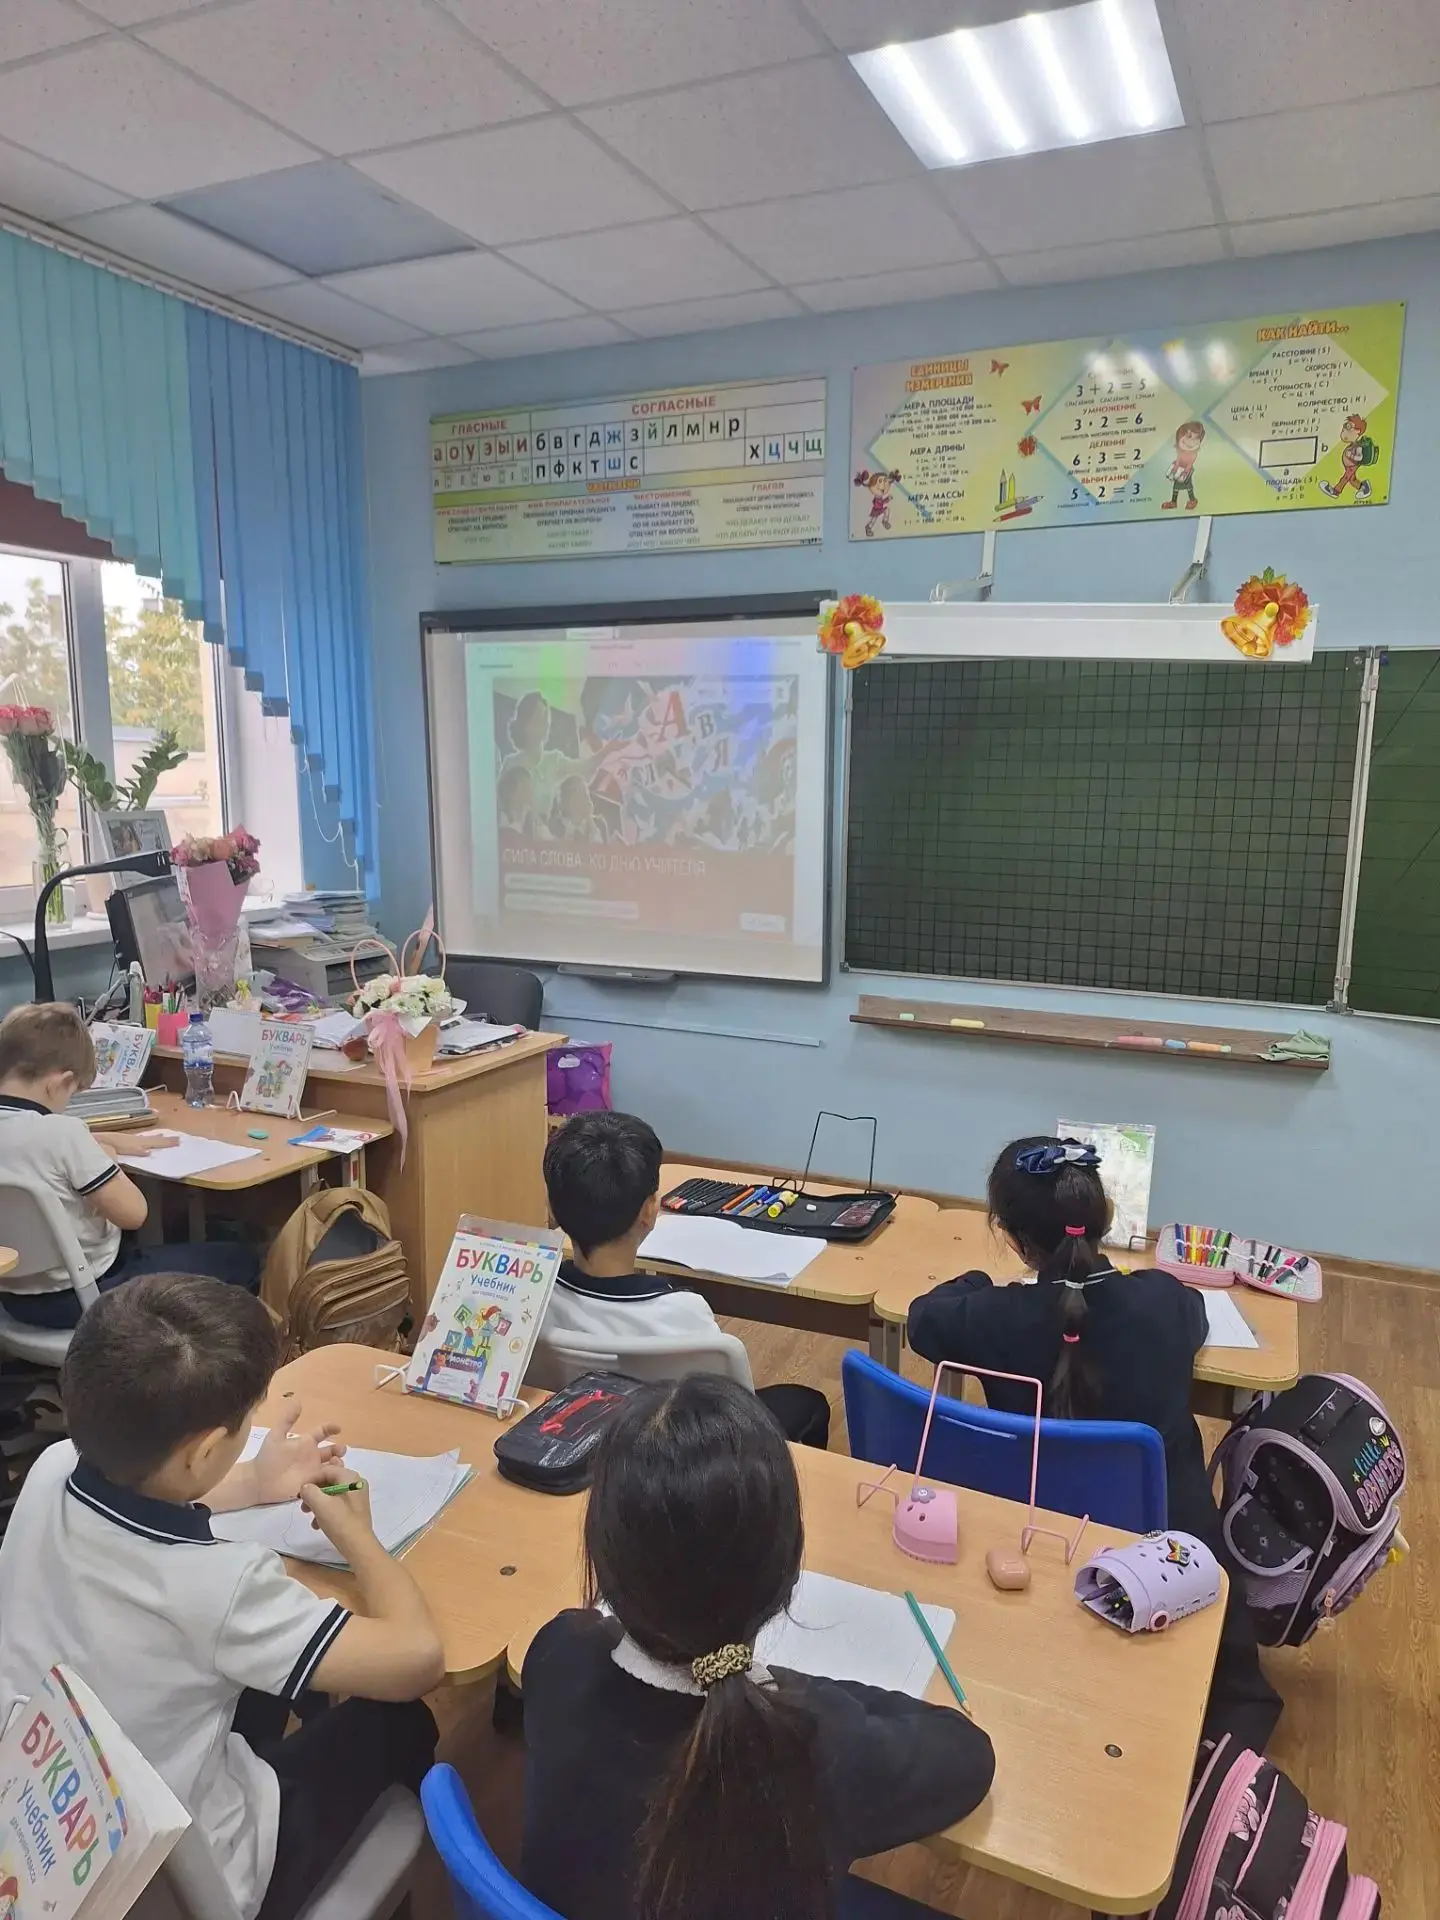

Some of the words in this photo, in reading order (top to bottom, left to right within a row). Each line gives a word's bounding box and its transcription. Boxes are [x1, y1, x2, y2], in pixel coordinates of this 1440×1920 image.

[1257, 327, 1286, 342] КАК
[911, 359, 969, 377] ЕДИНИЦЫ
[905, 373, 973, 392] ИЗМЕРЕНИЯ
[1076, 385, 1083, 397] 3
[1107, 382, 1115, 394] 2
[1139, 378, 1146, 390] 5
[1269, 382, 1312, 392] СТОИМОСТЬ
[632, 395, 717, 415] СОГЛАСНЫЕ
[904, 402, 926, 410] МЕРА
[929, 396, 974, 408] ПЛОЩАДИ
[1083, 403, 1136, 415] УМНОЖЕНИЕ
[452, 420, 508, 435] ГЛАСНЫЕ
[1074, 419, 1082, 431] 3
[1101, 416, 1108, 428] 2
[1135, 412, 1143, 425] 6
[536, 433, 546, 451] б
[554, 436, 563, 449] в
[574, 433, 581, 448] г
[589, 432, 600, 448] д
[607, 431, 621, 444] ж
[631, 428, 639, 441] з
[648, 422, 657, 439] й
[666, 424, 677, 438] л
[686, 423, 700, 436] м
[710, 420, 719, 434] н
[729, 418, 740, 436] р
[449, 446, 459, 460] о
[499, 440, 509, 454] ы
[516, 438, 527, 453] и
[910, 447, 931, 456] МЕРА
[935, 444, 965, 454] ДЛИНЫ
[1089, 439, 1126, 449] ДЕЛЕНИЕ
[1321, 443, 1328, 452] b
[536, 464, 546, 478] п
[553, 459, 565, 478] ф
[769, 442, 780, 459] ц
[788, 440, 799, 454] ч
[806, 438, 823, 455] щ
[1073, 455, 1080, 466] 6
[1098, 452, 1106, 464] 3
[1133, 448, 1141, 460] 2
[1081, 474, 1129, 484] ВЫЧИТАНИЕ
[1284, 468, 1289, 476] a
[1266, 478, 1302, 486] ПЛОЩАДЬ
[908, 494, 929, 502] МЕРА
[933, 490, 965, 499] МАССЫ
[1071, 488, 1078, 500] 5
[1098, 486, 1105, 498] 2
[1132, 483, 1140, 495] 3
[609, 855, 640, 873] ДНЮ
[644, 857, 706, 877] УЧИТЕЛЯ
[262, 1029, 307, 1046] БУКВАРЬ
[456, 1248, 543, 1283] БУКВАРЬ
[470, 1274, 516, 1294] Учебник
[21, 1711, 99, 1886] БУКВАРЬ
[17, 1779, 57, 1876] Учебник
